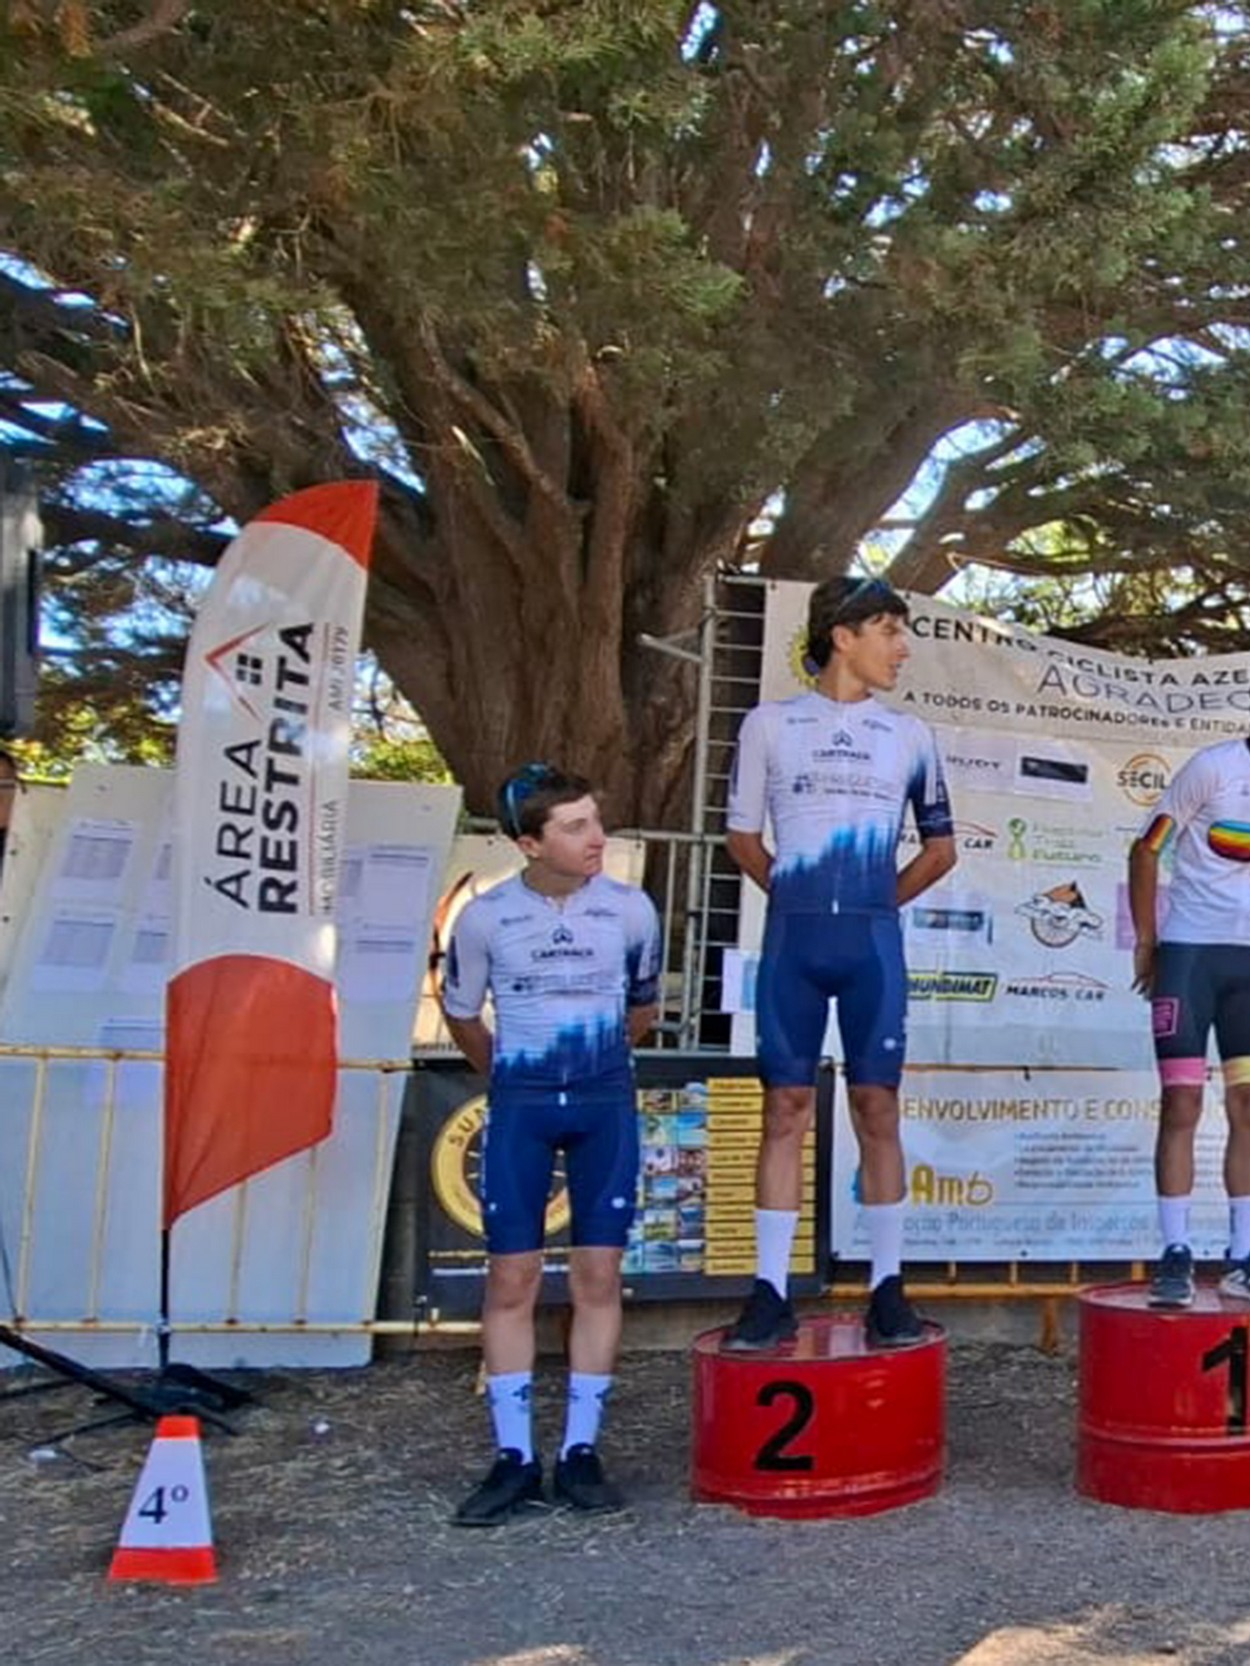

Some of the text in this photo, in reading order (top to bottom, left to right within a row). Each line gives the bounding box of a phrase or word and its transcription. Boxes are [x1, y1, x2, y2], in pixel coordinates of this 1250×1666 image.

[903, 691, 917, 702] A
[922, 691, 982, 711] TODOS
[987, 698, 1010, 715] OS
[257, 621, 315, 916] RESTRITA
[1116, 771, 1167, 790] SECIL
[204, 738, 263, 910] ÁREA
[963, 837, 993, 850] CAR
[1005, 984, 1105, 1001] MARCOS CAR
[903, 1098, 1080, 1122] ENVOLVIMENTO
[1202, 1326, 1249, 1436] 1
[754, 1381, 814, 1471] 2
